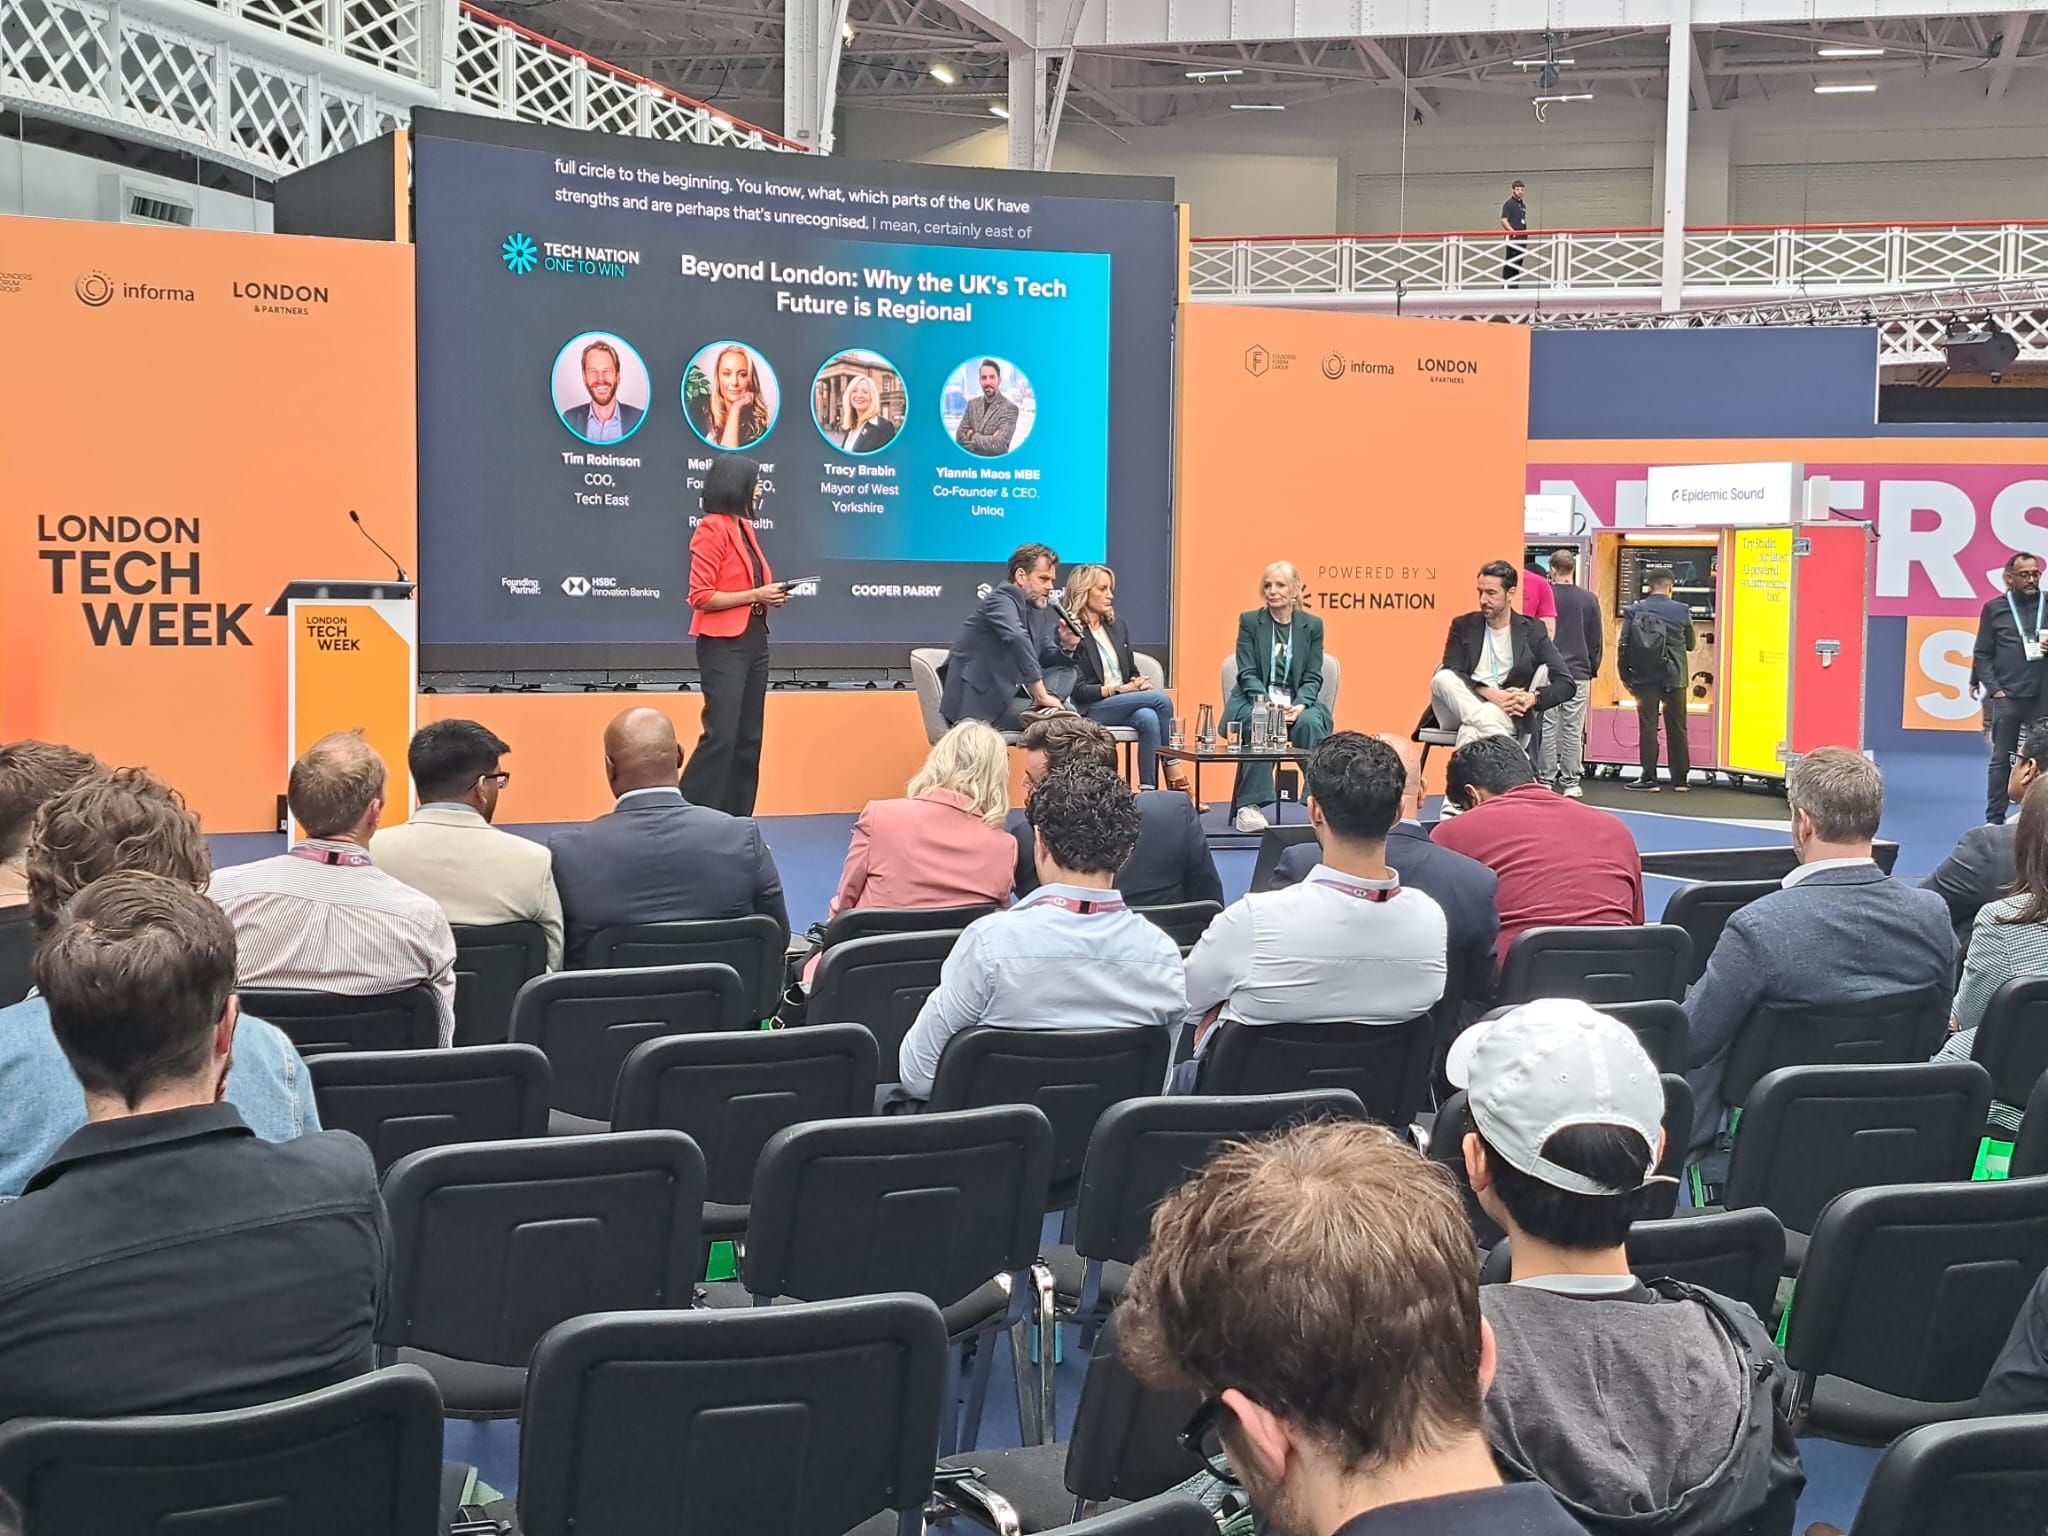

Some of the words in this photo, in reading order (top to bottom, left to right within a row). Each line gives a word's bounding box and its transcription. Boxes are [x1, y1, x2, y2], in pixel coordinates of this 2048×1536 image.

[554, 158, 575, 175] full
[578, 162, 616, 179] circle
[618, 167, 634, 182] to
[636, 168, 660, 185] the
[663, 171, 734, 194] beginning.
[736, 177, 762, 195] You
[765, 181, 805, 201] know,
[808, 186, 846, 203] what,
[848, 189, 888, 205] which
[891, 192, 927, 209] parts
[930, 195, 946, 208] of
[948, 196, 971, 210] the
[974, 197, 994, 212] UK
[997, 199, 1030, 214] have
[555, 187, 620, 208] strengths
[622, 196, 648, 211] and
[651, 201, 673, 213] are
[675, 202, 730, 221] perhaps
[733, 206, 771, 222] that's
[774, 211, 869, 230] unrecognised.
[872, 217, 876, 230] I
[880, 220, 920, 234] mean,
[924, 221, 981, 240] certainly
[984, 226, 1013, 239] east
[1017, 226, 1032, 239] of
[544, 242, 582, 258] TECH
[585, 246, 640, 265] NATION
[544, 257, 575, 272] ONE
[576, 260, 595, 274] TO
[599, 262, 625, 277] WIN
[681, 254, 764, 283] Beyond
[770, 262, 858, 288] London:
[863, 268, 912, 295] Why
[917, 272, 953, 294] the
[959, 274, 1008, 296] UK's
[1014, 276, 1067, 298] Tech
[123, 282, 195, 302] informa
[233, 281, 329, 303] LONDON
[254, 305, 261, 313] &
[262, 305, 309, 316] PARTNERS
[776, 291, 848, 316] Future
[854, 296, 871, 317] is
[877, 298, 972, 325] Regional
[1350, 360, 1394, 375] informa
[1417, 358, 1477, 374] LONDON
[562, 452, 584, 466] Tim
[586, 453, 641, 467] Robinson
[824, 463, 856, 478] Tracy
[858, 464, 896, 477] Brabin
[980, 468, 1011, 480] Maos
[1014, 469, 1041, 480] MBE
[584, 473, 616, 488] COO,
[820, 482, 856, 496] Mayor
[858, 483, 870, 495] of
[871, 483, 900, 496] West
[933, 485, 998, 497] Co-Founder
[1001, 487, 1009, 497] &
[1681, 487, 1728, 503] Epidemic
[1730, 486, 1764, 500] Sound
[574, 492, 602, 505] Tech
[604, 494, 630, 507] East
[832, 501, 885, 514] Yorkshire
[38, 514, 200, 544] LONDON
[39, 549, 200, 595] TECH
[1319, 565, 1394, 579] POWERED
[1402, 567, 1419, 579] BY
[501, 577, 539, 588] Founding
[592, 577, 617, 587] HSBC
[592, 587, 630, 597] Innovation
[631, 588, 660, 599] Banking
[851, 584, 901, 596] COOPER
[902, 585, 942, 597] PARRY
[1318, 592, 1365, 609] TECH
[1370, 592, 1435, 609] NATION
[81, 602, 254, 646] WEEK
[306, 616, 347, 625] LONDON
[307, 626, 347, 637] TECH
[317, 639, 360, 651] WEEK
